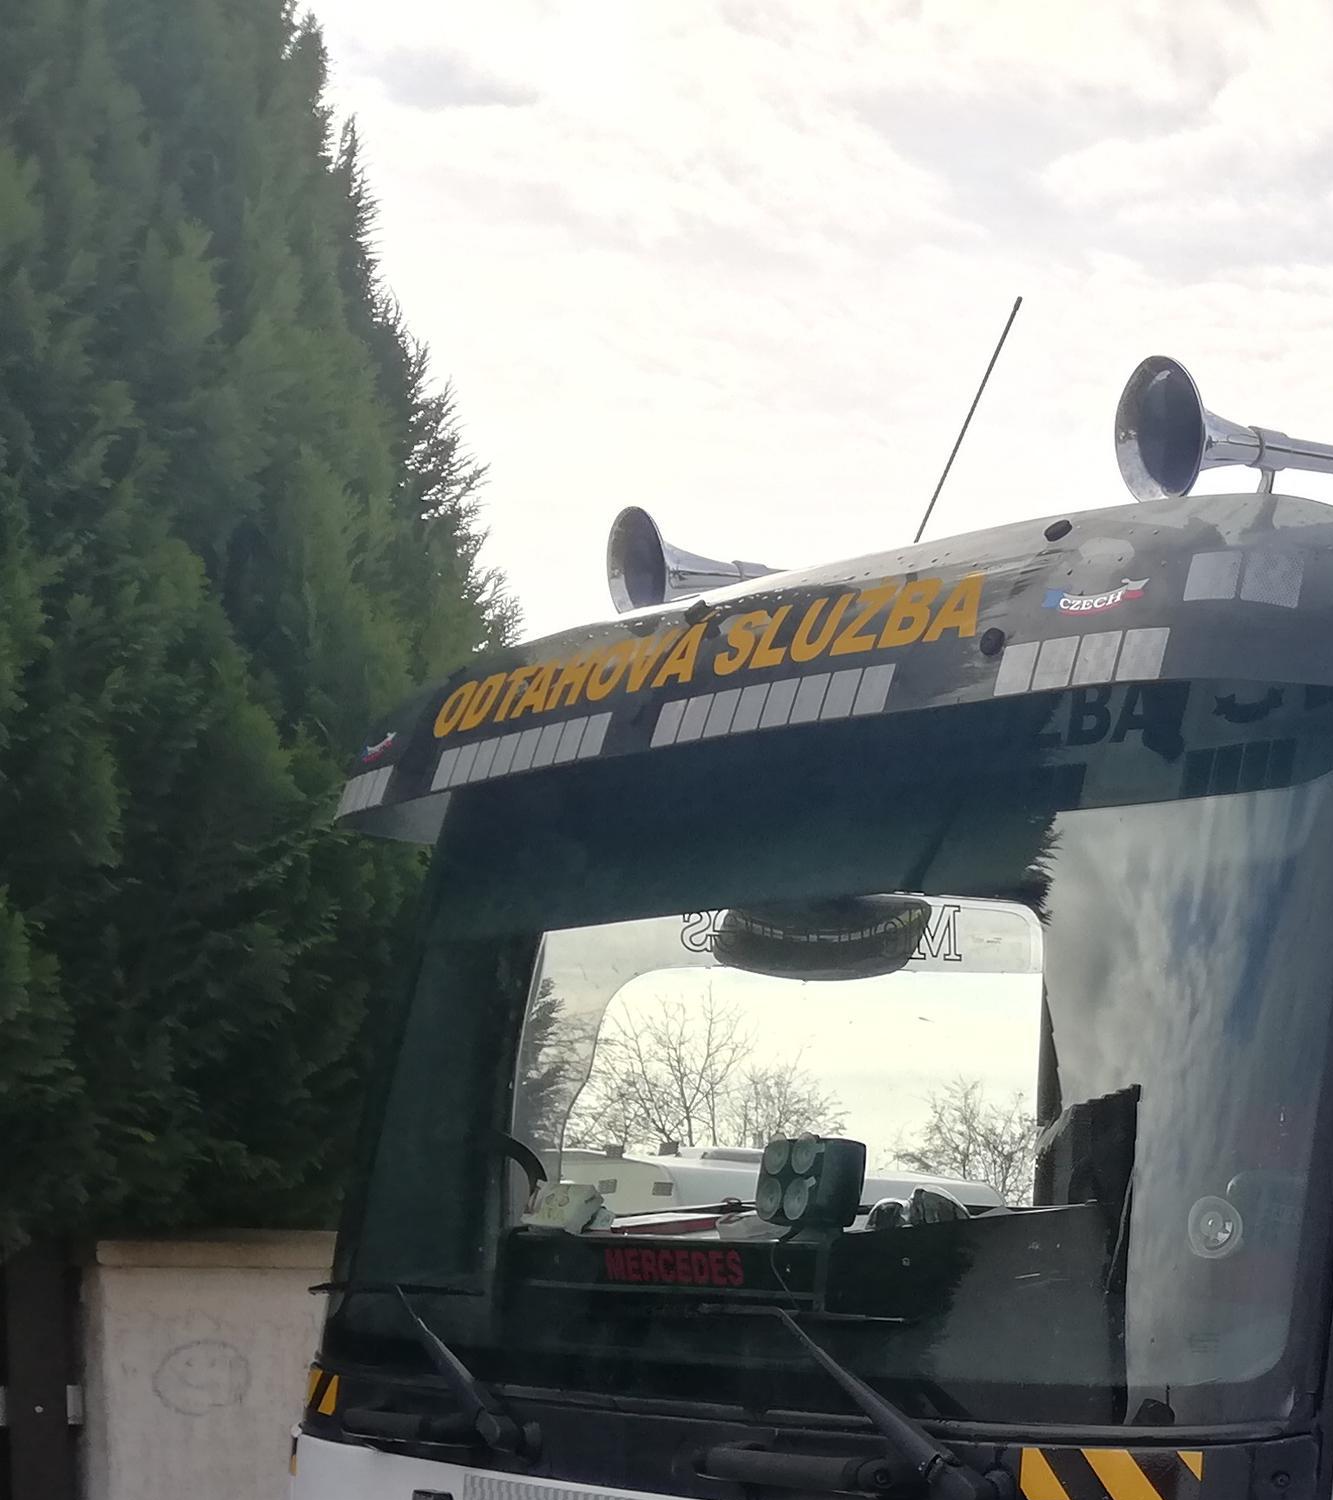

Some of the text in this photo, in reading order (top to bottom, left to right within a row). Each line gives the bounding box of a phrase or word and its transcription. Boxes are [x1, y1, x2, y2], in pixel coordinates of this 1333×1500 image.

[1059, 591, 1124, 611] CZECH
[433, 570, 986, 738] ODTAHOVÁ SLUŽBA
[604, 1248, 745, 1286] MERCEDES
